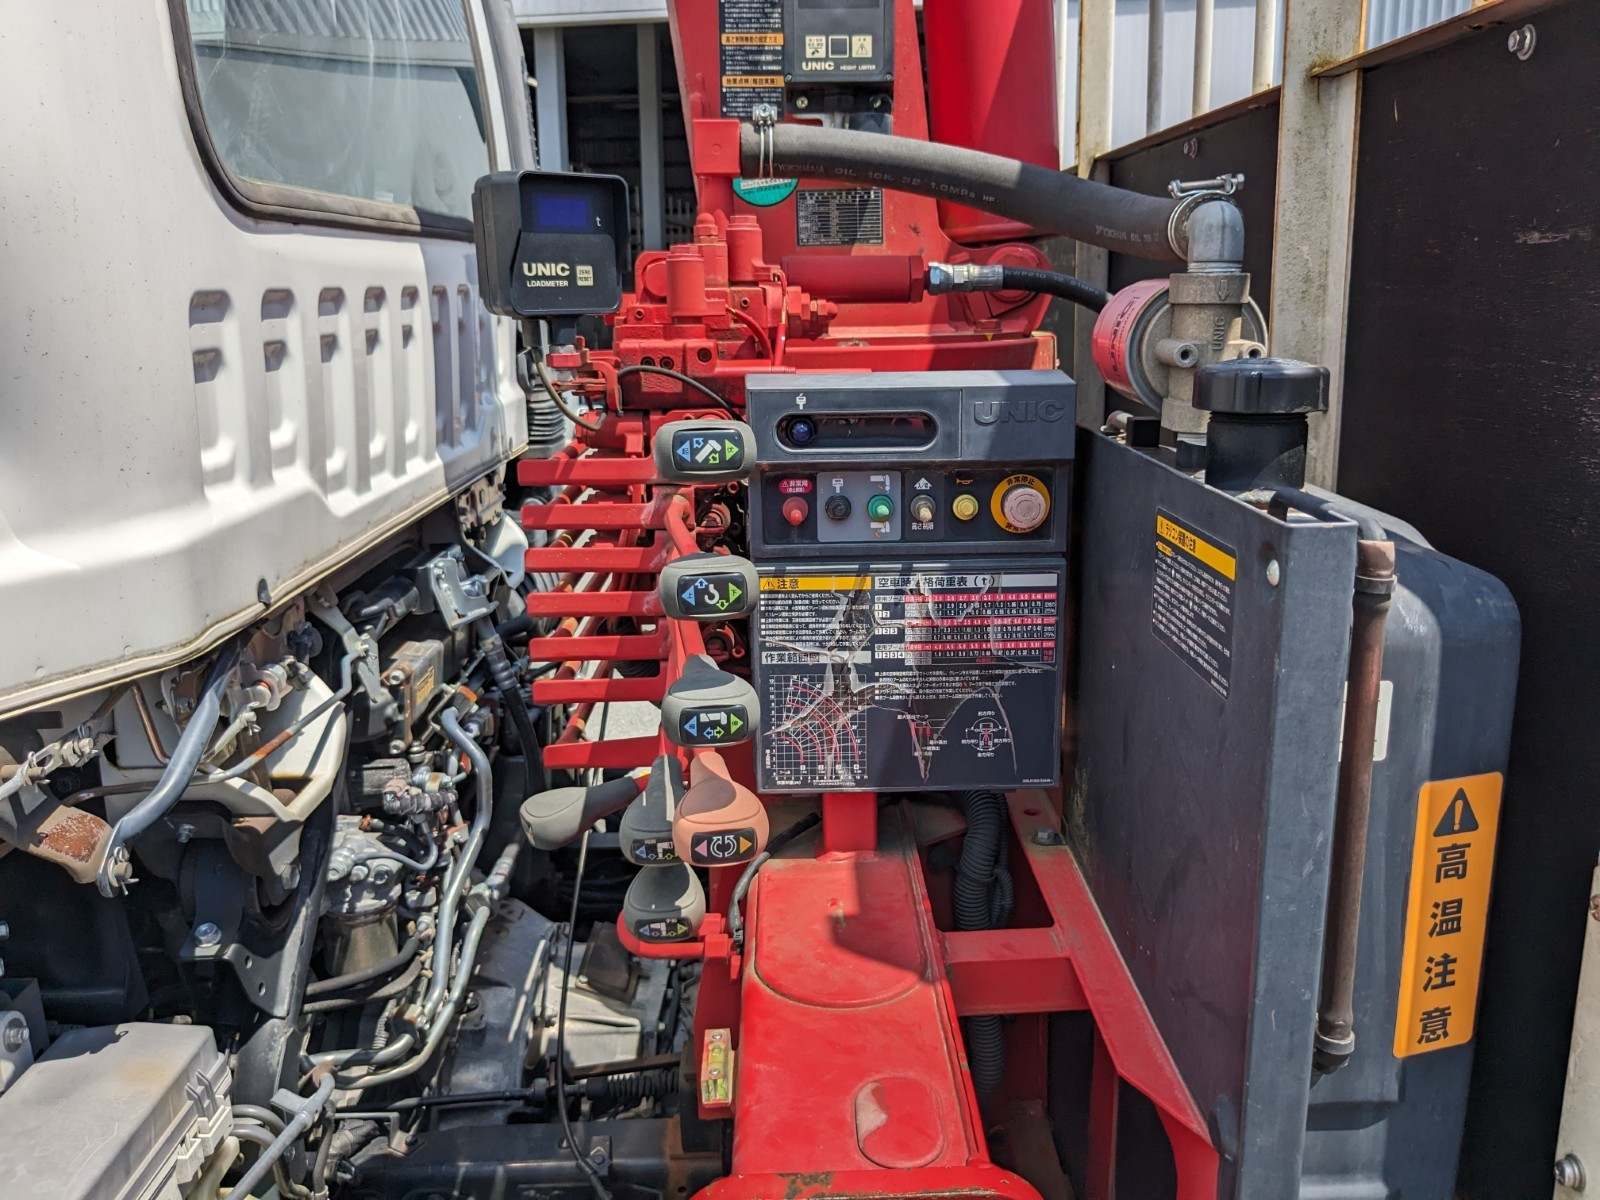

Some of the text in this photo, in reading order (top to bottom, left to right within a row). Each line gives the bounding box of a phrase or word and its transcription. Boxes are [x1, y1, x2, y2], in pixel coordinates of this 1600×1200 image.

[802, 62, 834, 70] UNIC
[596, 216, 602, 227] t
[522, 262, 571, 276] UNIC
[1212, 317, 1225, 350] UNIC
[974, 400, 1066, 426] UNIC
[1006, 476, 1036, 486] 非常停止
[912, 522, 934, 530] 高さ制限
[777, 578, 800, 590] 注意
[878, 576, 968, 588] 空車時格荷重表
[1416, 842, 1472, 1045] 高温注意
